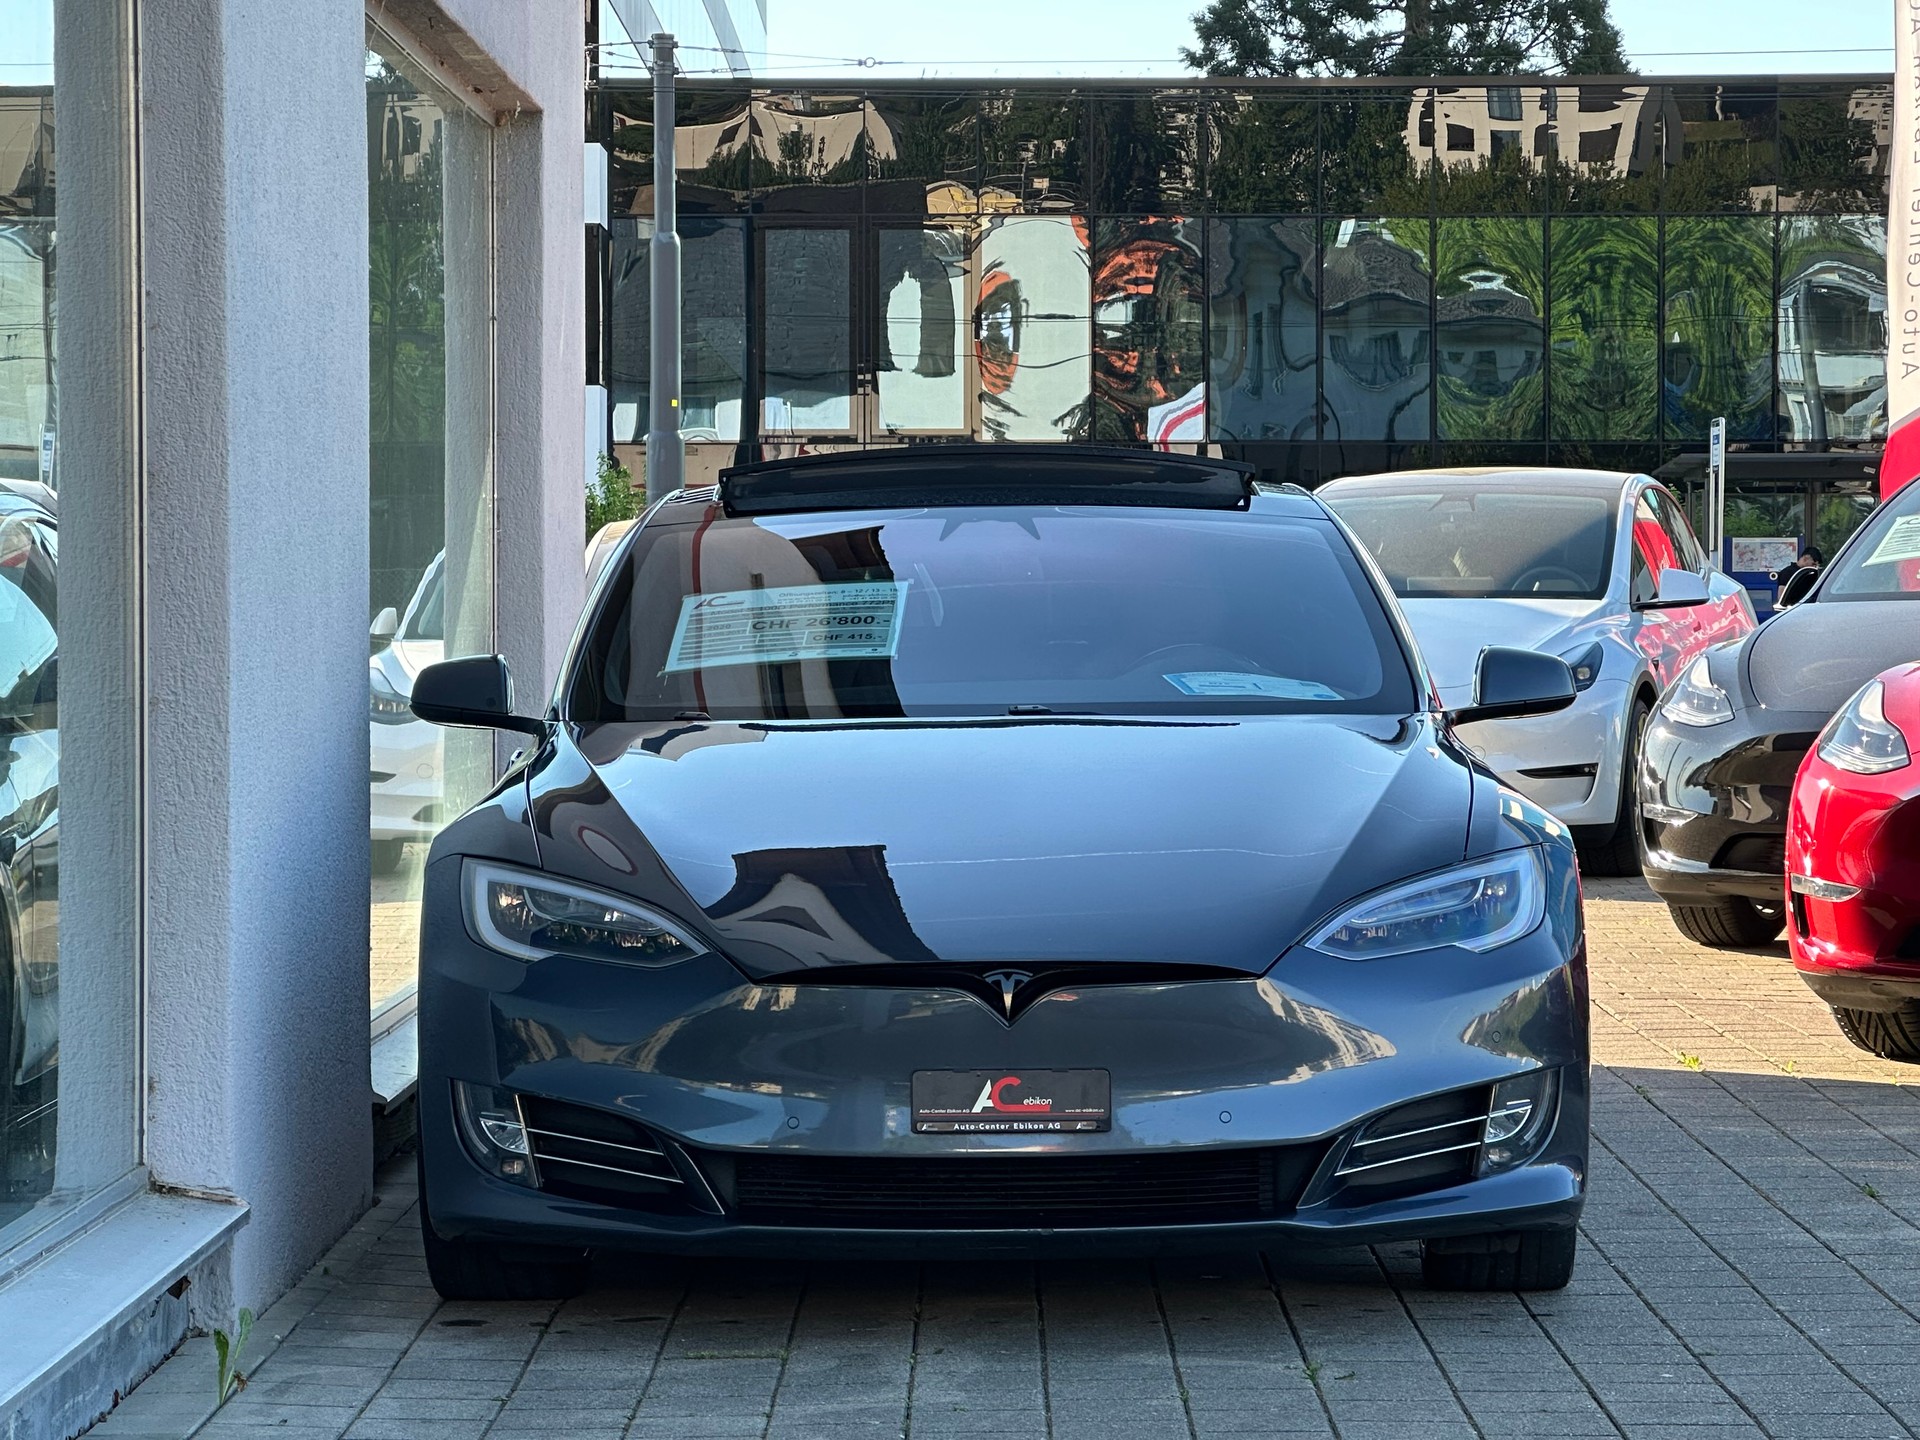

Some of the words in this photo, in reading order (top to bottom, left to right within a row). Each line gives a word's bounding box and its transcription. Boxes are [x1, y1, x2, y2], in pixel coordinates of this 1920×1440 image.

[752, 619, 798, 631] CHF
[805, 615, 890, 627] 26'800.-
[812, 633, 844, 641] CHF
[847, 632, 883, 641] 415.-
[1022, 1096, 1053, 1106] ebikon
[953, 1123, 1010, 1131] Auto-Center
[1013, 1122, 1045, 1130] Ebikon
[1047, 1121, 1061, 1130] AG
